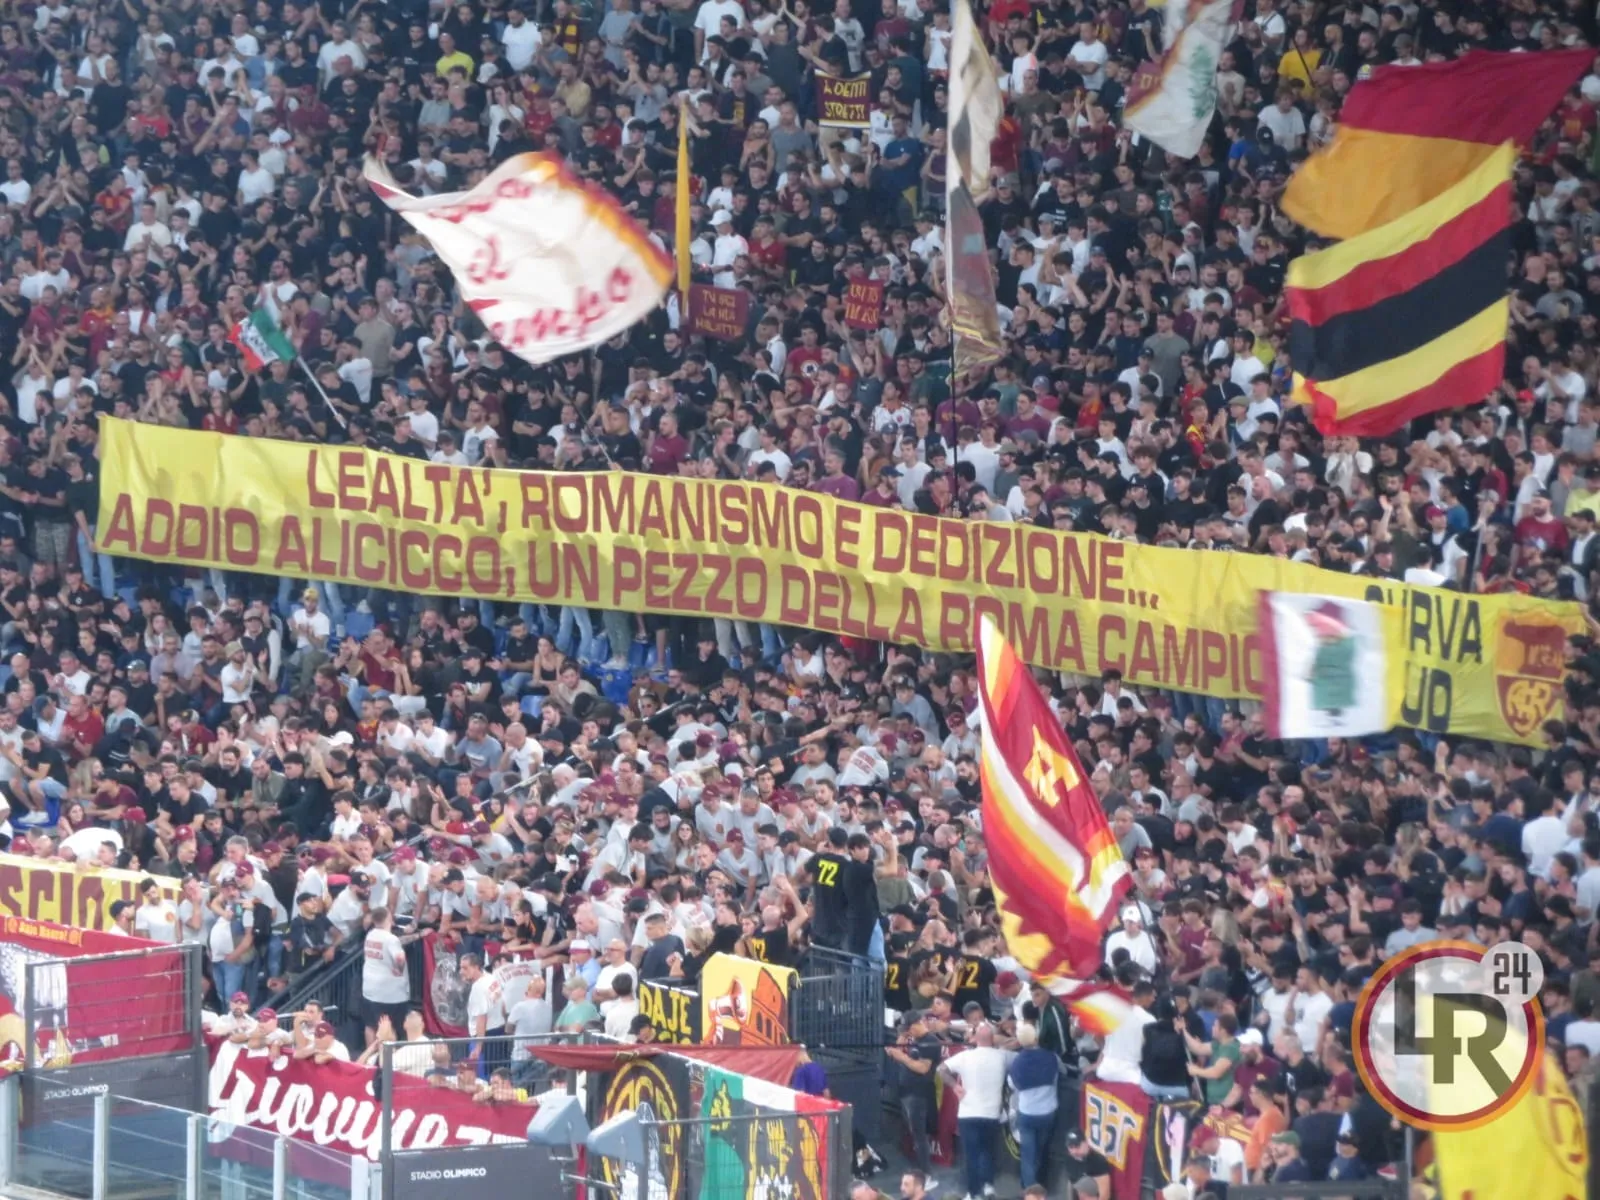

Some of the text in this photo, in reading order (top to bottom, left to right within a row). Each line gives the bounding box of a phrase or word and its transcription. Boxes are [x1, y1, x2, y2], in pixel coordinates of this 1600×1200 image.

[521, 473, 823, 559] ROMANISMO
[835, 505, 861, 568] E
[874, 512, 1159, 610] DEDIZIONE...
[103, 493, 259, 566] ADDIO
[528, 542, 599, 601] UN
[612, 547, 768, 616] PEZZO
[780, 564, 925, 648] DELLA
[818, 859, 839, 887] 72
[640, 983, 691, 1035] DAJE
[410, 1167, 487, 1181] STADIO OLIMPICO
